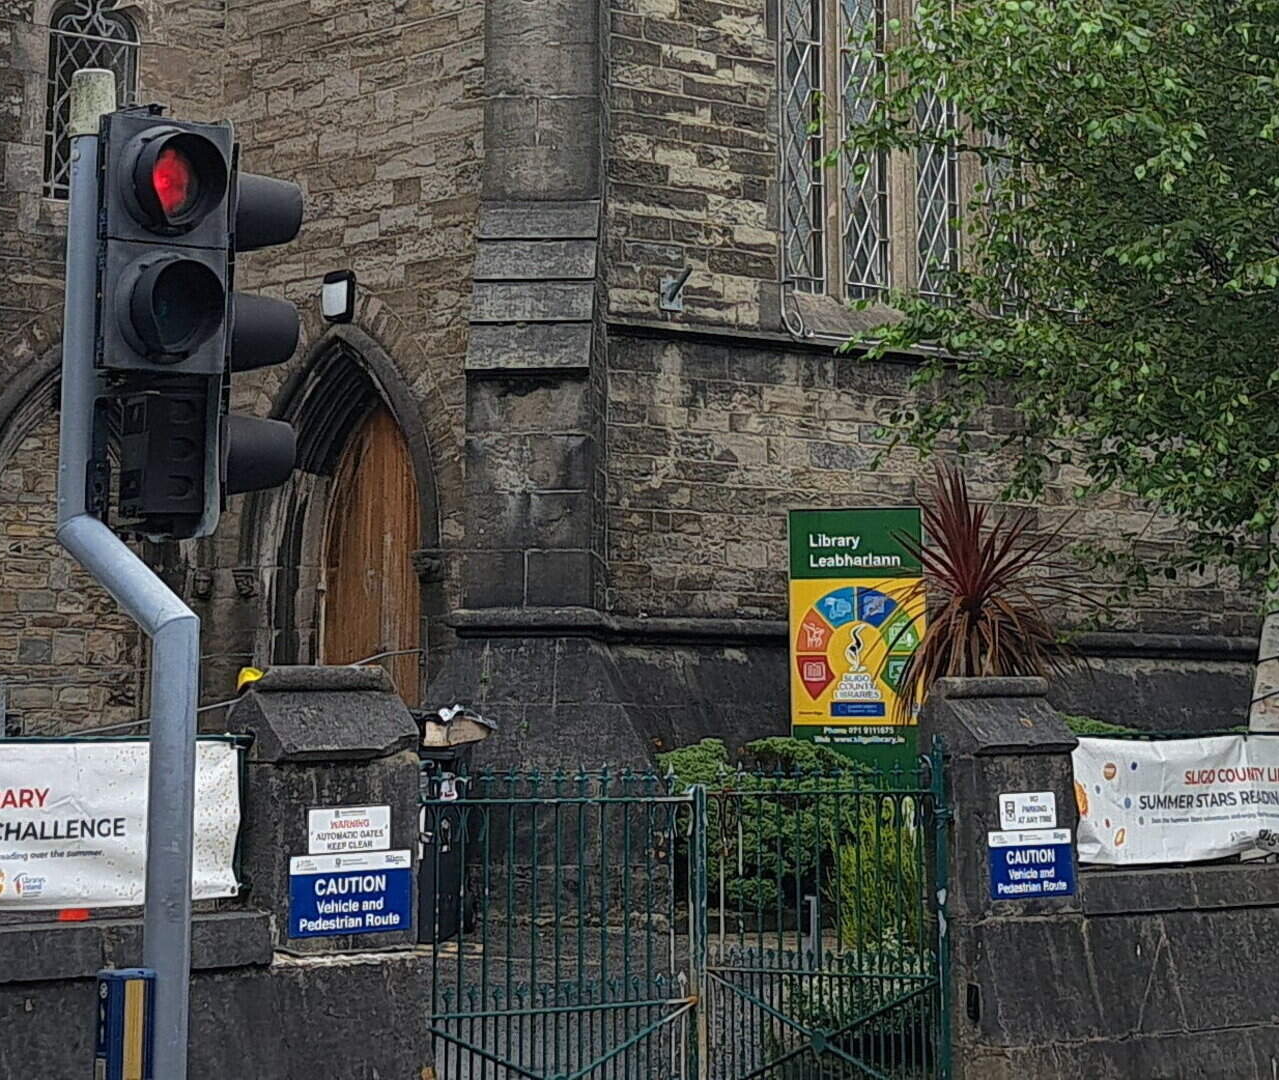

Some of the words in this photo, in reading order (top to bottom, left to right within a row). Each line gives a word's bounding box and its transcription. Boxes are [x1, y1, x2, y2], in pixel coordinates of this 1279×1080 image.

[809, 533, 860, 550] Library
[809, 553, 901, 568] Leabharlann
[1184, 770, 1216, 785] SLIGO
[1217, 768, 1265, 783] COUNTY
[1139, 794, 1194, 810] SUMMER
[1196, 792, 1238, 808] STARS
[330, 819, 370, 830] WARNING
[316, 831, 358, 841] AUTOMATIC
[360, 829, 384, 839] GATES
[327, 842, 347, 850] KEEP
[348, 840, 373, 849] CLEAR
[30, 851, 49, 860] over
[50, 849, 65, 858] the
[66, 849, 105, 858] summer.
[1006, 848, 1056, 865] CAUTION
[1008, 867, 1038, 880] Vehicle
[1040, 867, 1055, 878] and
[314, 875, 386, 896] CAUTION
[997, 882, 1041, 894] Pedestrian
[1043, 880, 1067, 891] Route
[316, 899, 359, 914] Vehicle
[362, 897, 384, 910] and
[299, 915, 363, 932] Pedestrian
[365, 912, 400, 926] Route
